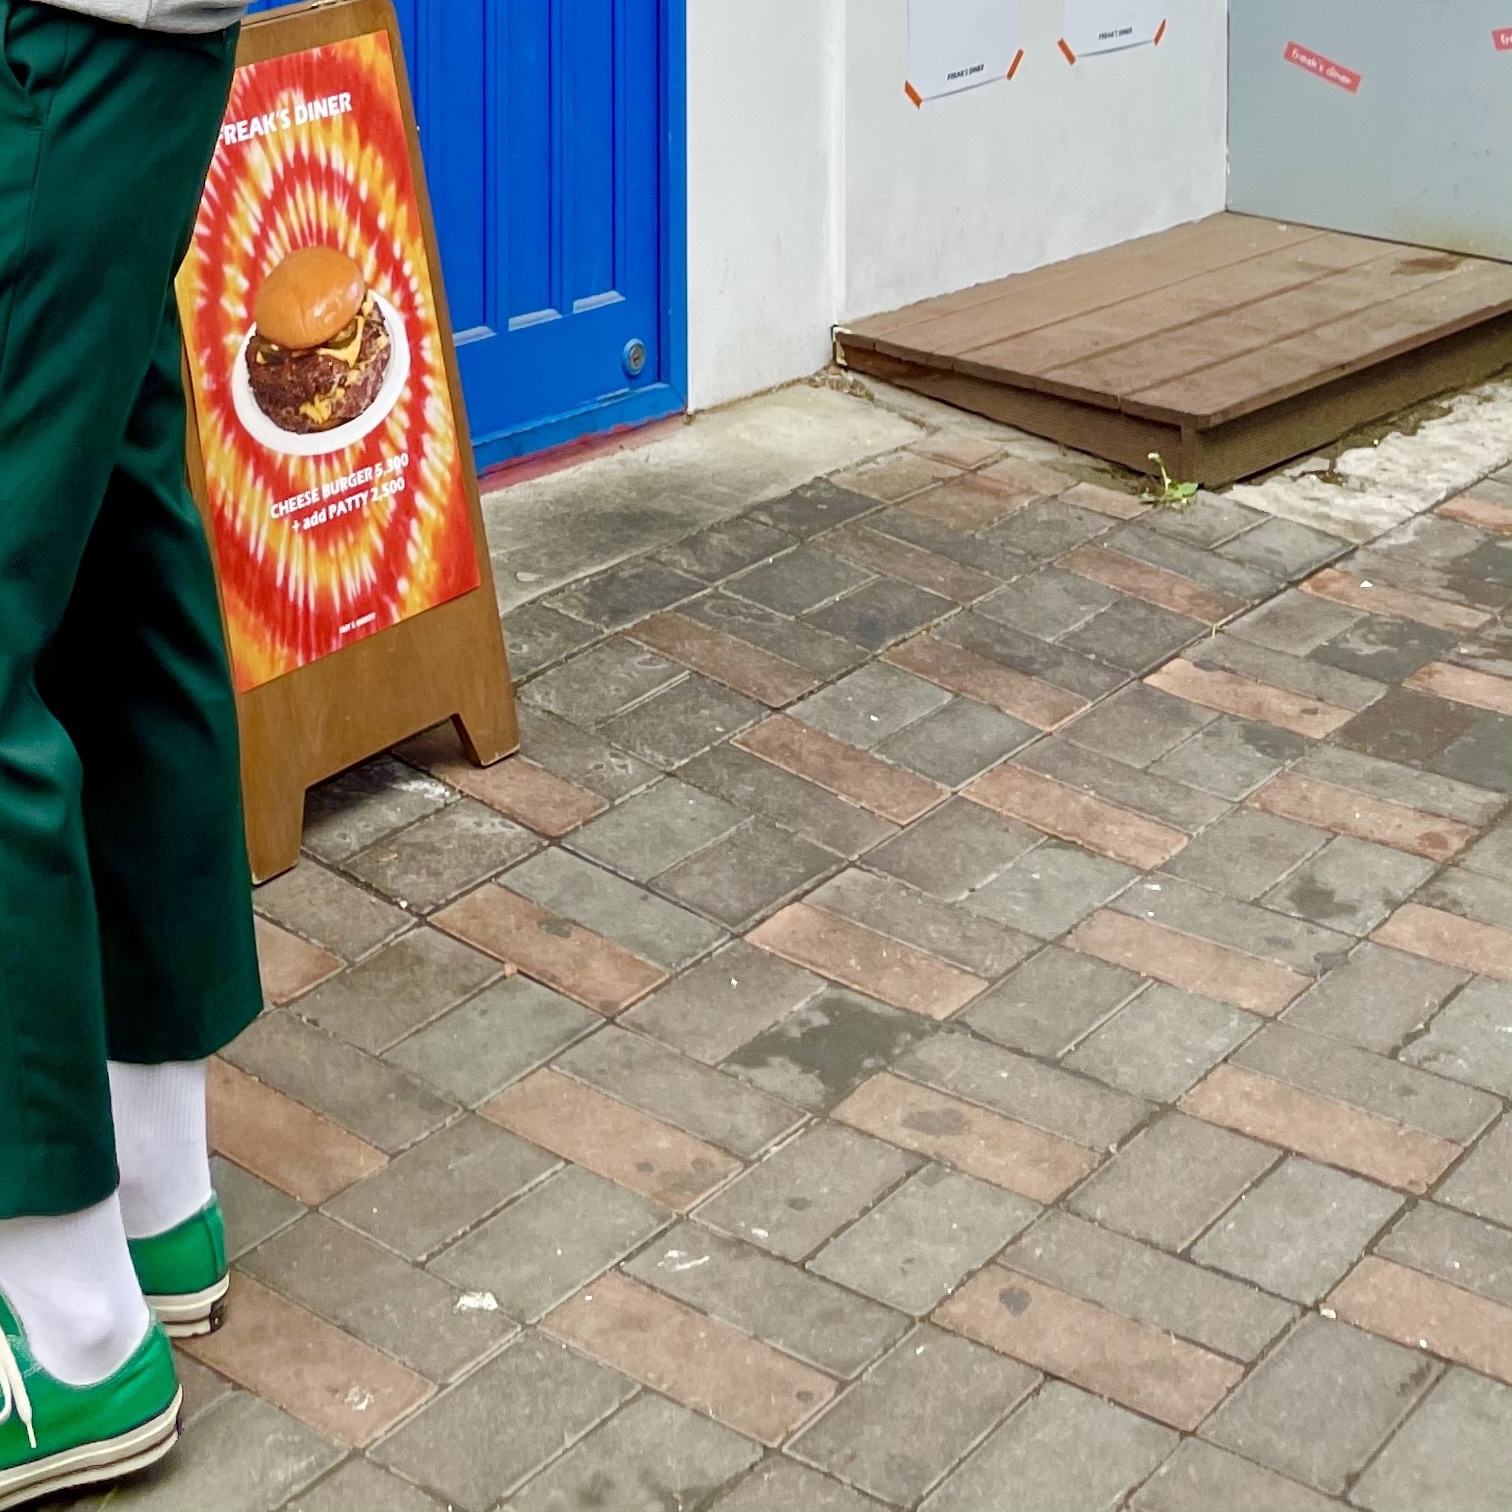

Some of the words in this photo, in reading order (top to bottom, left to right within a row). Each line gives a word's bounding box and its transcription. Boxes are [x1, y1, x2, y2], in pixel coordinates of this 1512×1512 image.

[295, 91, 353, 126] DINER
[270, 487, 321, 520] CHEESE
[321, 466, 374, 501] BURGER
[302, 508, 327, 531] add
[328, 489, 369, 521] PATTY
